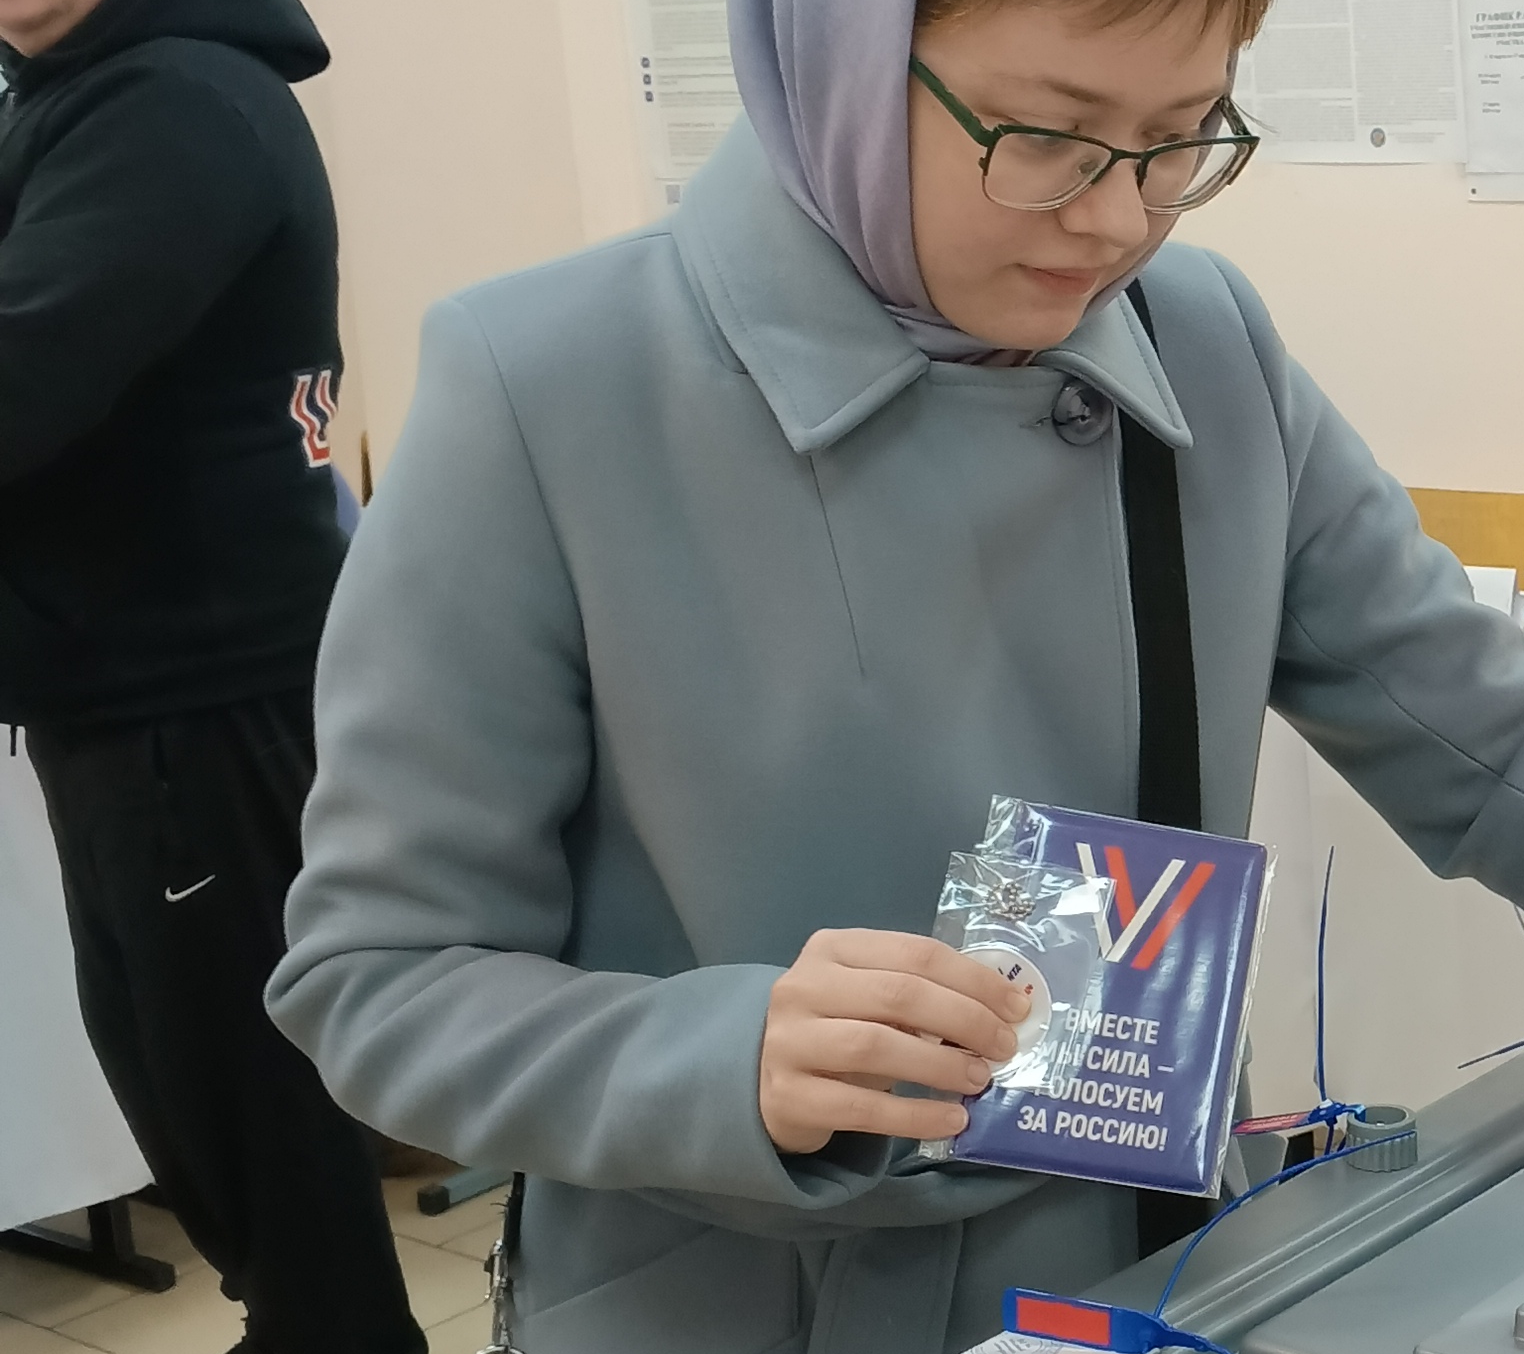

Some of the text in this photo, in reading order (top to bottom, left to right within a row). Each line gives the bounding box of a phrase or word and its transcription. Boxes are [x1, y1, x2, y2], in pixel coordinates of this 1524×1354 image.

[1064, 1009, 1161, 1045] ВМЕСТЕ
[1086, 1046, 1152, 1078] СИЛА
[1034, 1075, 1165, 1116] ОЛОСУЕМ
[1017, 1104, 1169, 1153] ЗА РОССИЮ!
